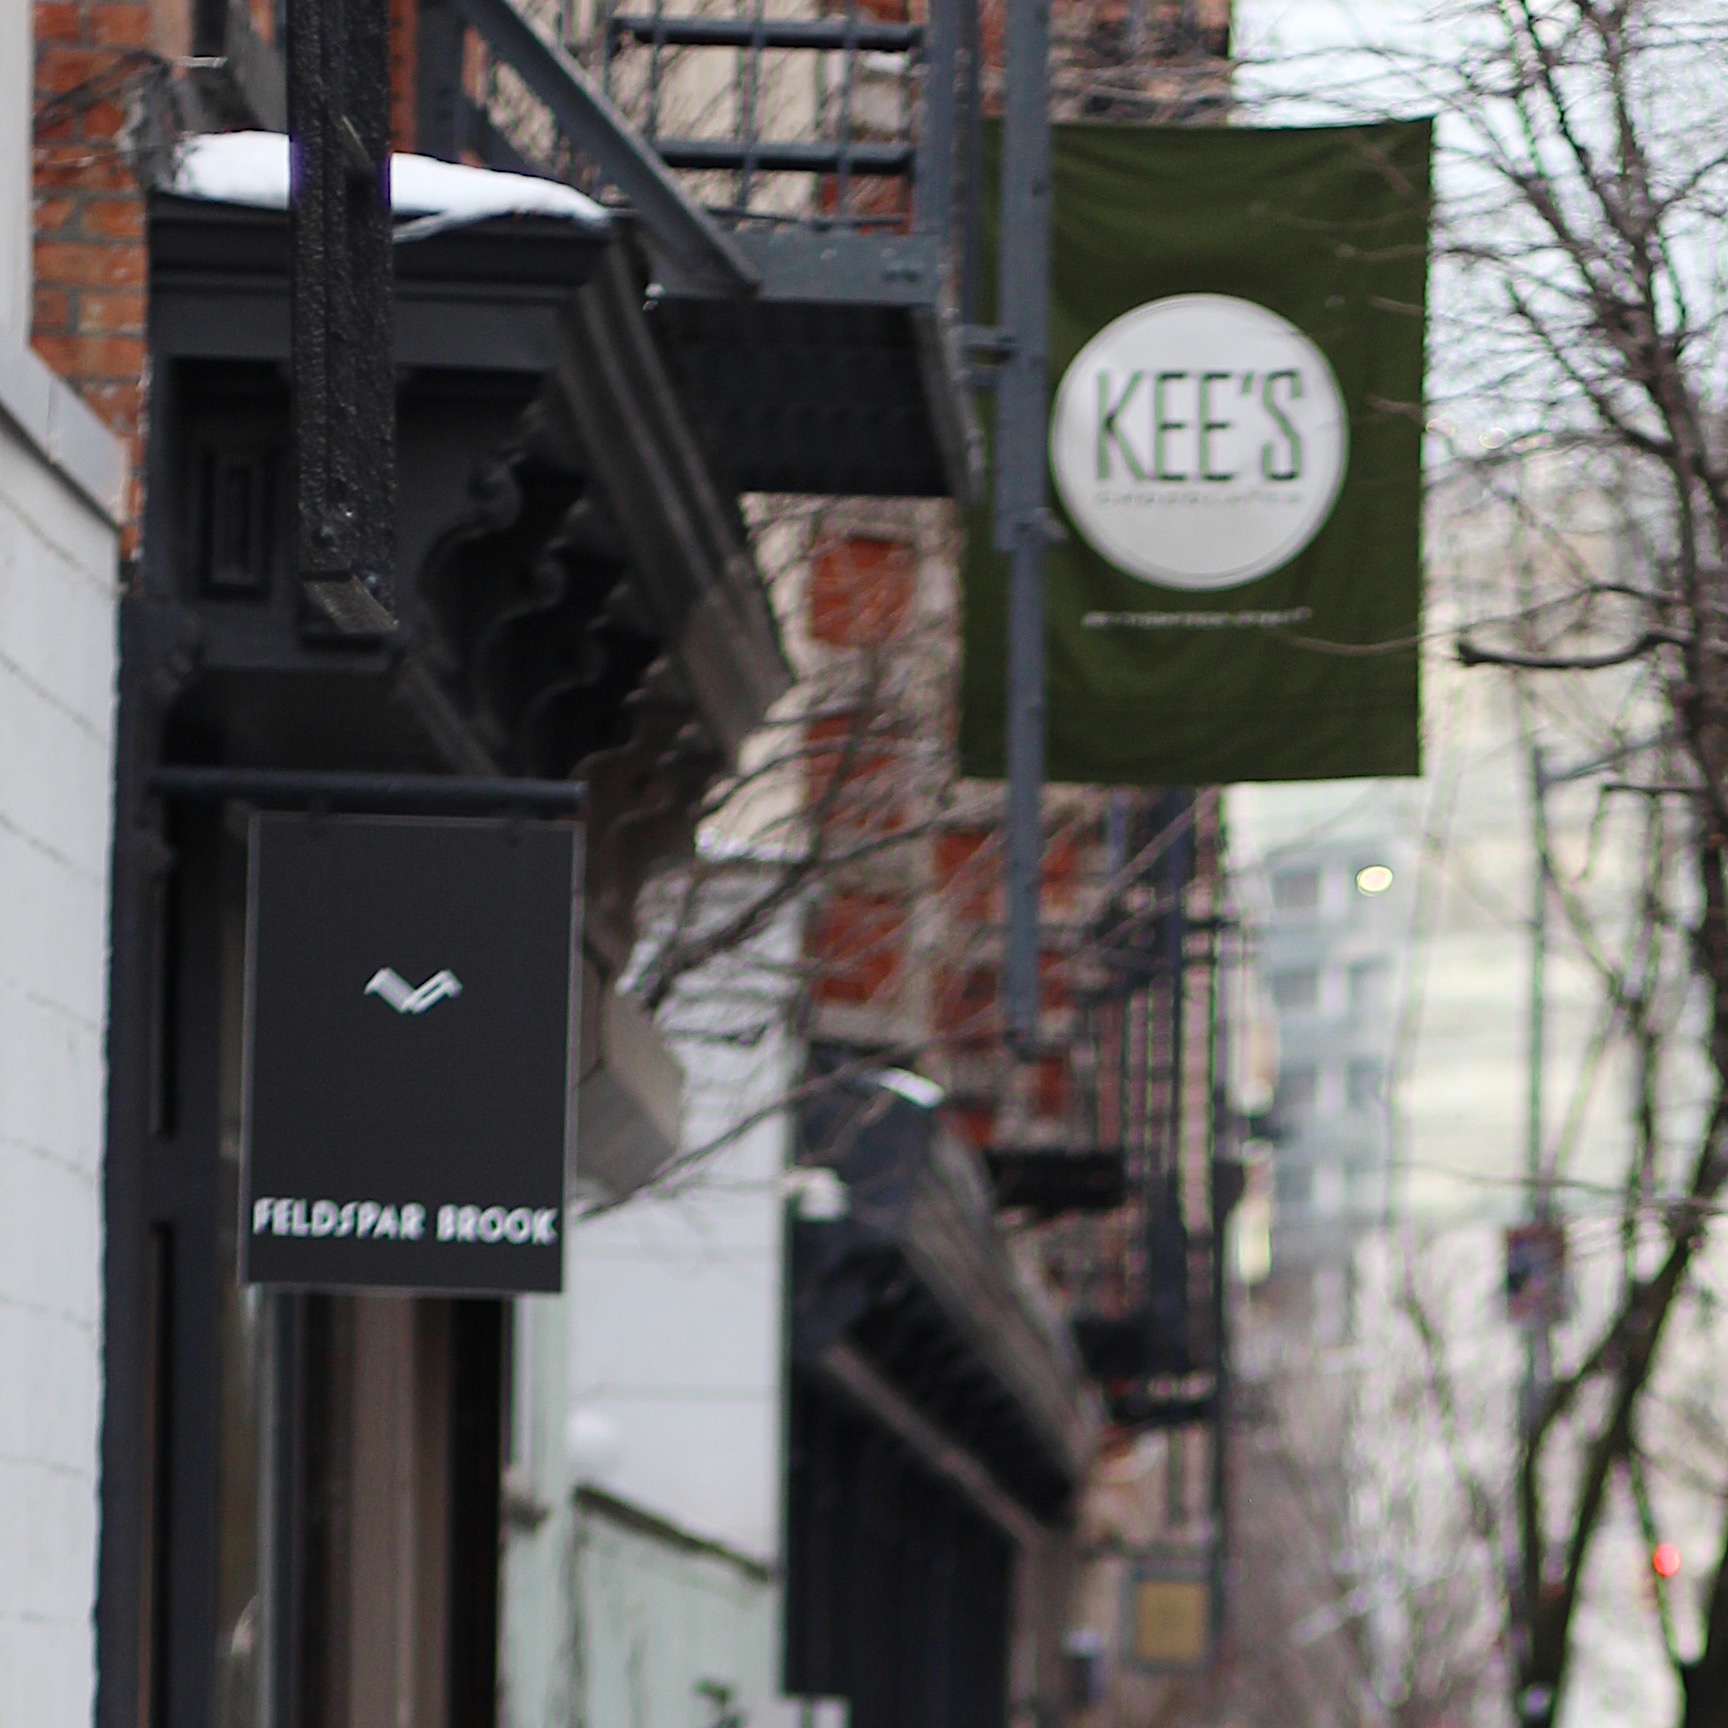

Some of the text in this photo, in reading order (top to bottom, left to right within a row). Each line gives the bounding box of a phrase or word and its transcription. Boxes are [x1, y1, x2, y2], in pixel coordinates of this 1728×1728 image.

[1097, 369, 1305, 482] KEE'S
[253, 1198, 557, 1245] FELDSPAR BROOK
